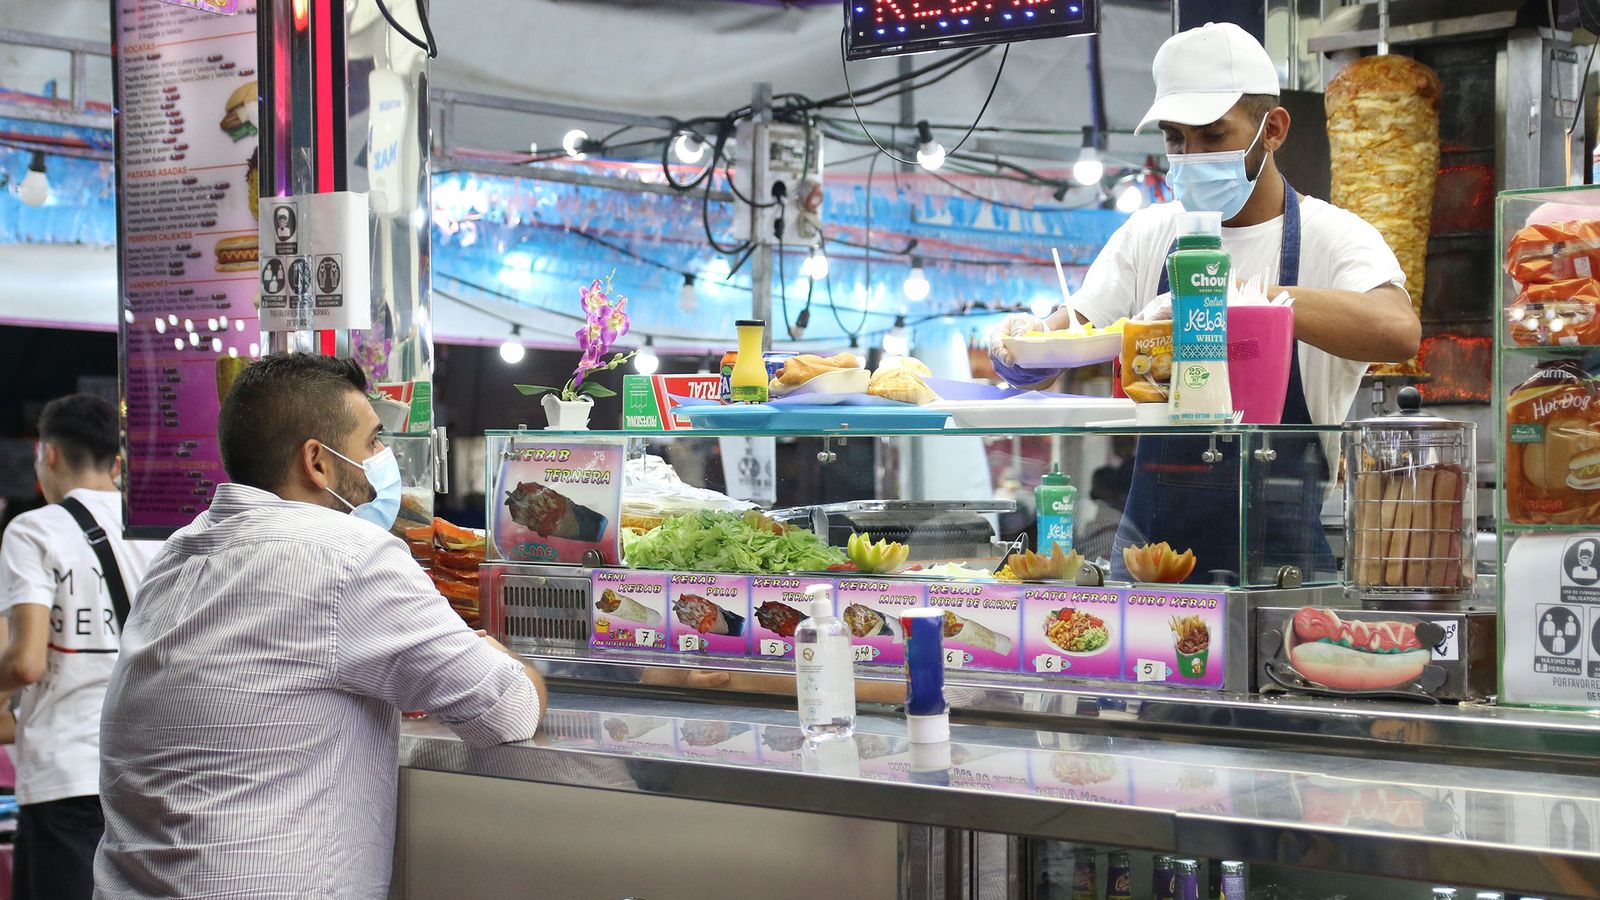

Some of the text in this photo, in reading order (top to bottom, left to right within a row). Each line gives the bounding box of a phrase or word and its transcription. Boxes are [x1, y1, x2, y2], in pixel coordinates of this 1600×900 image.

[124, 43, 156, 55] BOCATAS
[127, 166, 188, 179] PATATAS ASADAS
[128, 231, 193, 243] PERRITOS CALIENTES
[128, 280, 169, 289] SANDWICHES
[1191, 272, 1227, 287] Choví
[1203, 296, 1223, 307] Salsa
[1532, 392, 1592, 420] Hot Dog
[544, 468, 612, 485] TERNERA
[597, 571, 628, 583] MENU
[671, 574, 717, 586] KEBAB
[617, 583, 663, 595] KEBAB
[752, 578, 801, 590] KEBAB
[838, 581, 889, 592] KEBAB
[928, 584, 983, 596] KEBAB
[706, 586, 739, 599] POLLO
[1025, 590, 1119, 604] PLATO KEBAB
[878, 594, 918, 605] MIXTO
[930, 596, 1019, 610] DOBLE DE CARNE
[1127, 594, 1218, 610] CUBO KEBAB
[642, 631, 650, 643] 7
[685, 637, 694, 648] 5
[770, 642, 779, 654] 5
[946, 650, 953, 663] 6
[1045, 656, 1053, 669] 6
[1540, 656, 1566, 665] MÁXIMO
[1143, 662, 1153, 675] 5
[1548, 664, 1581, 674] PERSONAS
[1552, 676, 1567, 688] POR
[1567, 677, 1590, 690] FAVOR
[1586, 691, 1597, 701] DE
